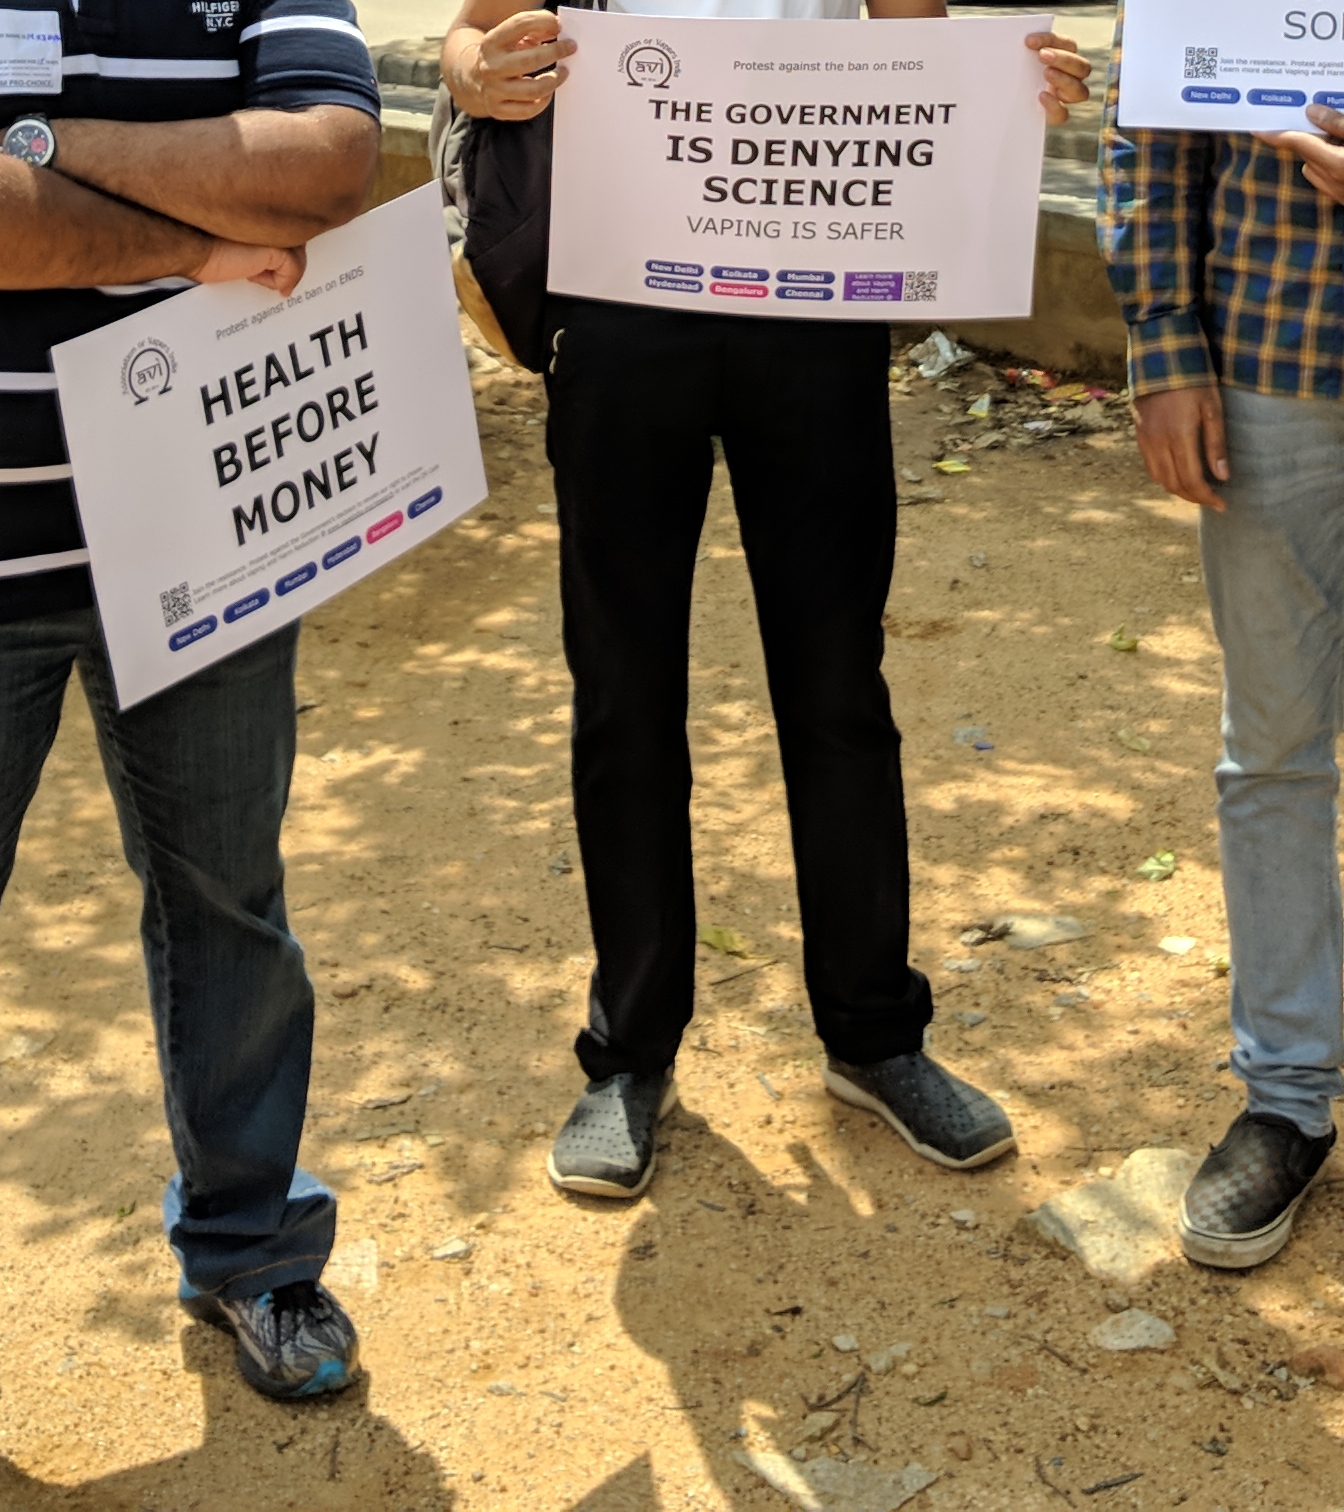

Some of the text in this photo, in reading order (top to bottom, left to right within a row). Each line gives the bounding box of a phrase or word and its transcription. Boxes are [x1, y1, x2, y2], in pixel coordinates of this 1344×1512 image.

[733, 60, 924, 73] Protest against the ban on ENDS
[648, 98, 957, 125] THE GOVERNMENT
[666, 134, 933, 167] IS DENYING
[703, 176, 893, 207] SCIENCE
[686, 215, 904, 240] VAPING IS SAFER
[787, 273, 824, 281] Mumbai
[215, 265, 364, 340] Protest against the ban on ENDS
[785, 289, 824, 298] Chennai
[200, 311, 368, 426] HEALTH
[213, 371, 378, 488] BEFORE
[232, 432, 378, 546] MONEY
